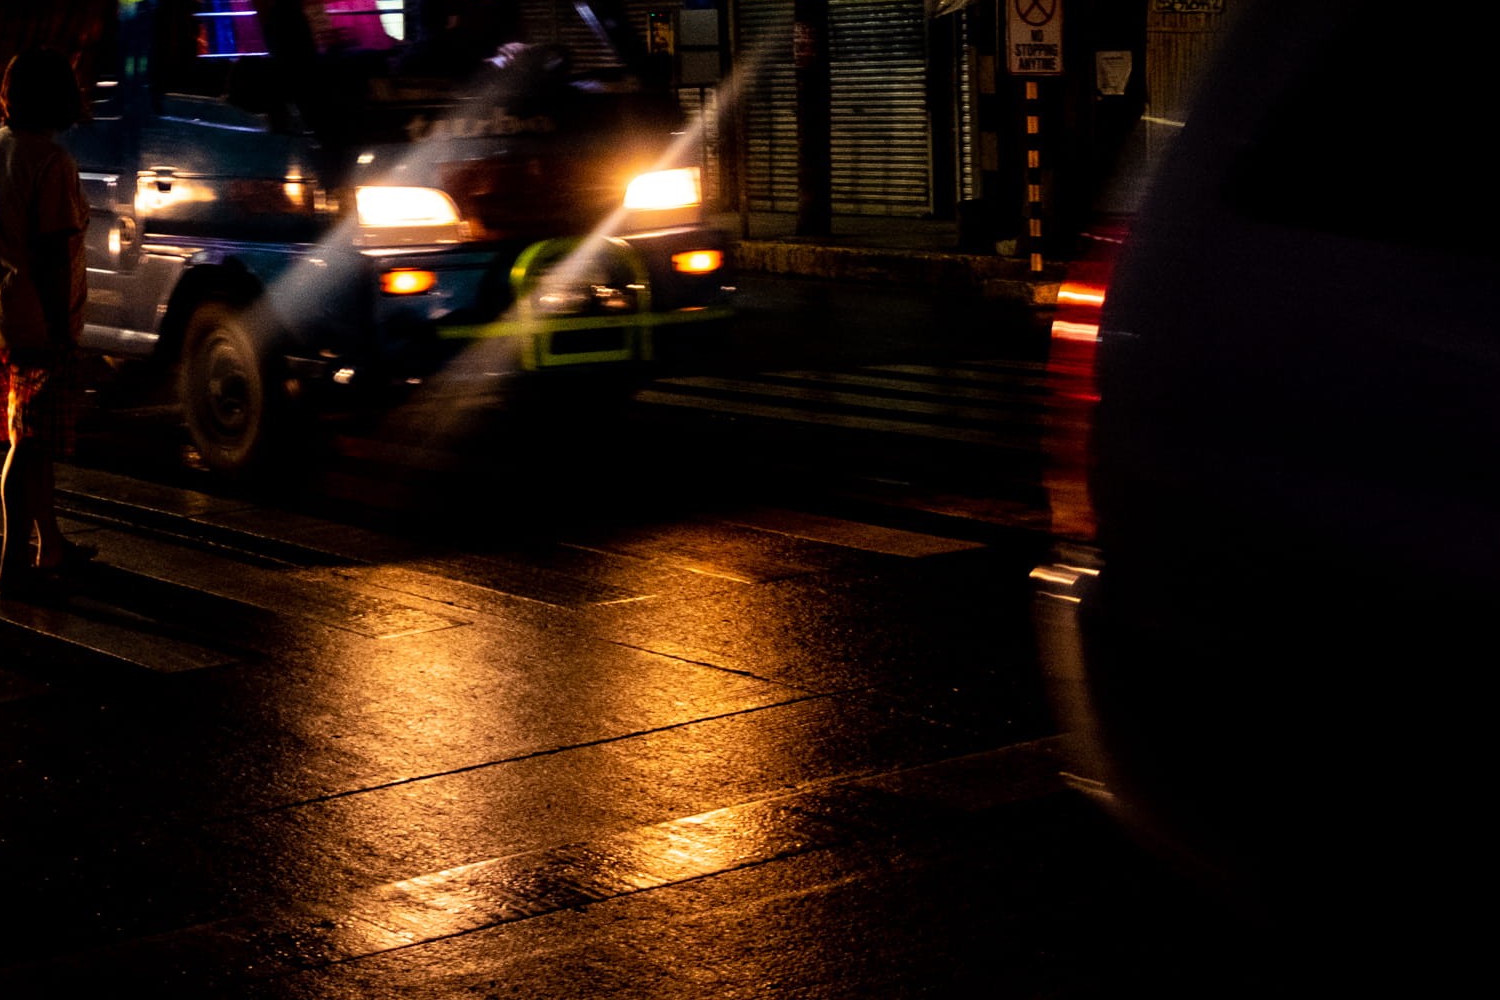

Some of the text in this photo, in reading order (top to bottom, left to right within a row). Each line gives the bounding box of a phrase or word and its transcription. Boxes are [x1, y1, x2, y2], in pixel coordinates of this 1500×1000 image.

[1030, 29, 1044, 42] NO
[1015, 43, 1058, 57] STOPPING
[1018, 57, 1056, 70] ANYTIME
